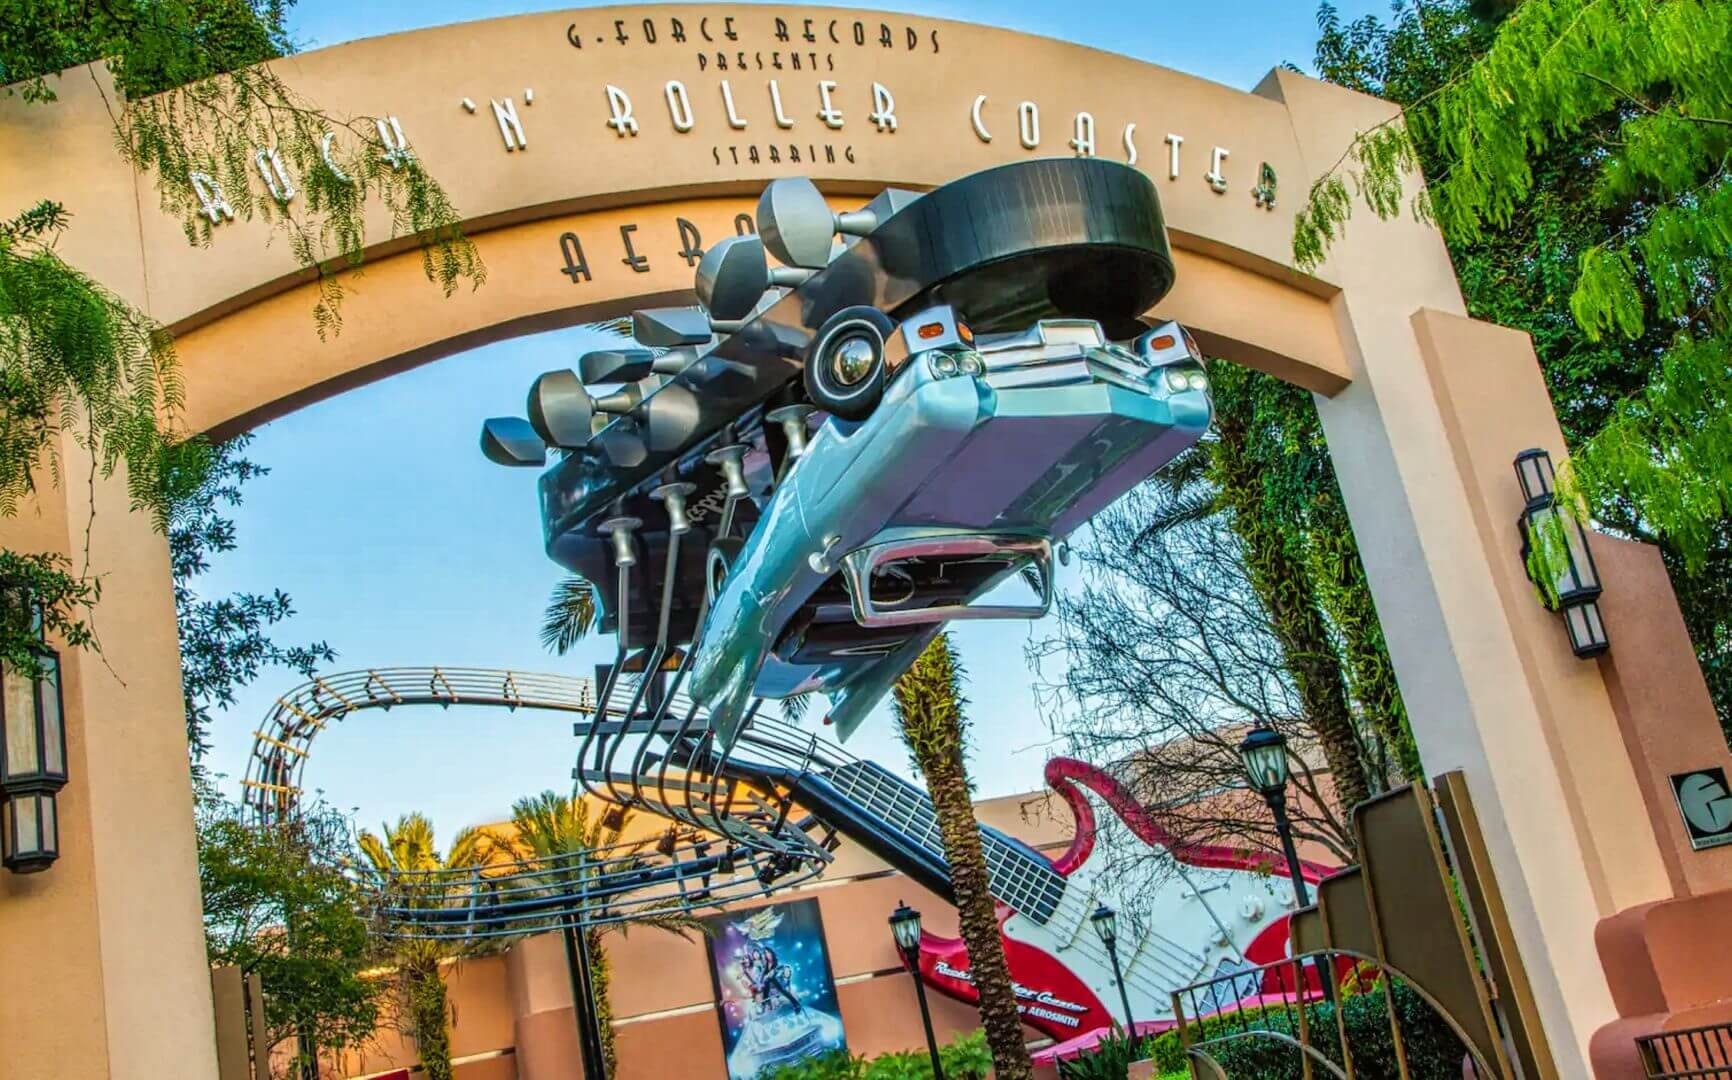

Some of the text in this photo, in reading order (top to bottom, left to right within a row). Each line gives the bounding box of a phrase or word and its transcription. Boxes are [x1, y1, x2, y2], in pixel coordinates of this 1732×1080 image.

[775, 17, 940, 54] RECORDS
[698, 52, 835, 72] PRESENTS
[605, 79, 898, 137] ROLLER
[970, 94, 1279, 210] COASTER
[712, 144, 856, 166] STARRING
[1027, 1005, 1080, 1029] AEROSMITH
